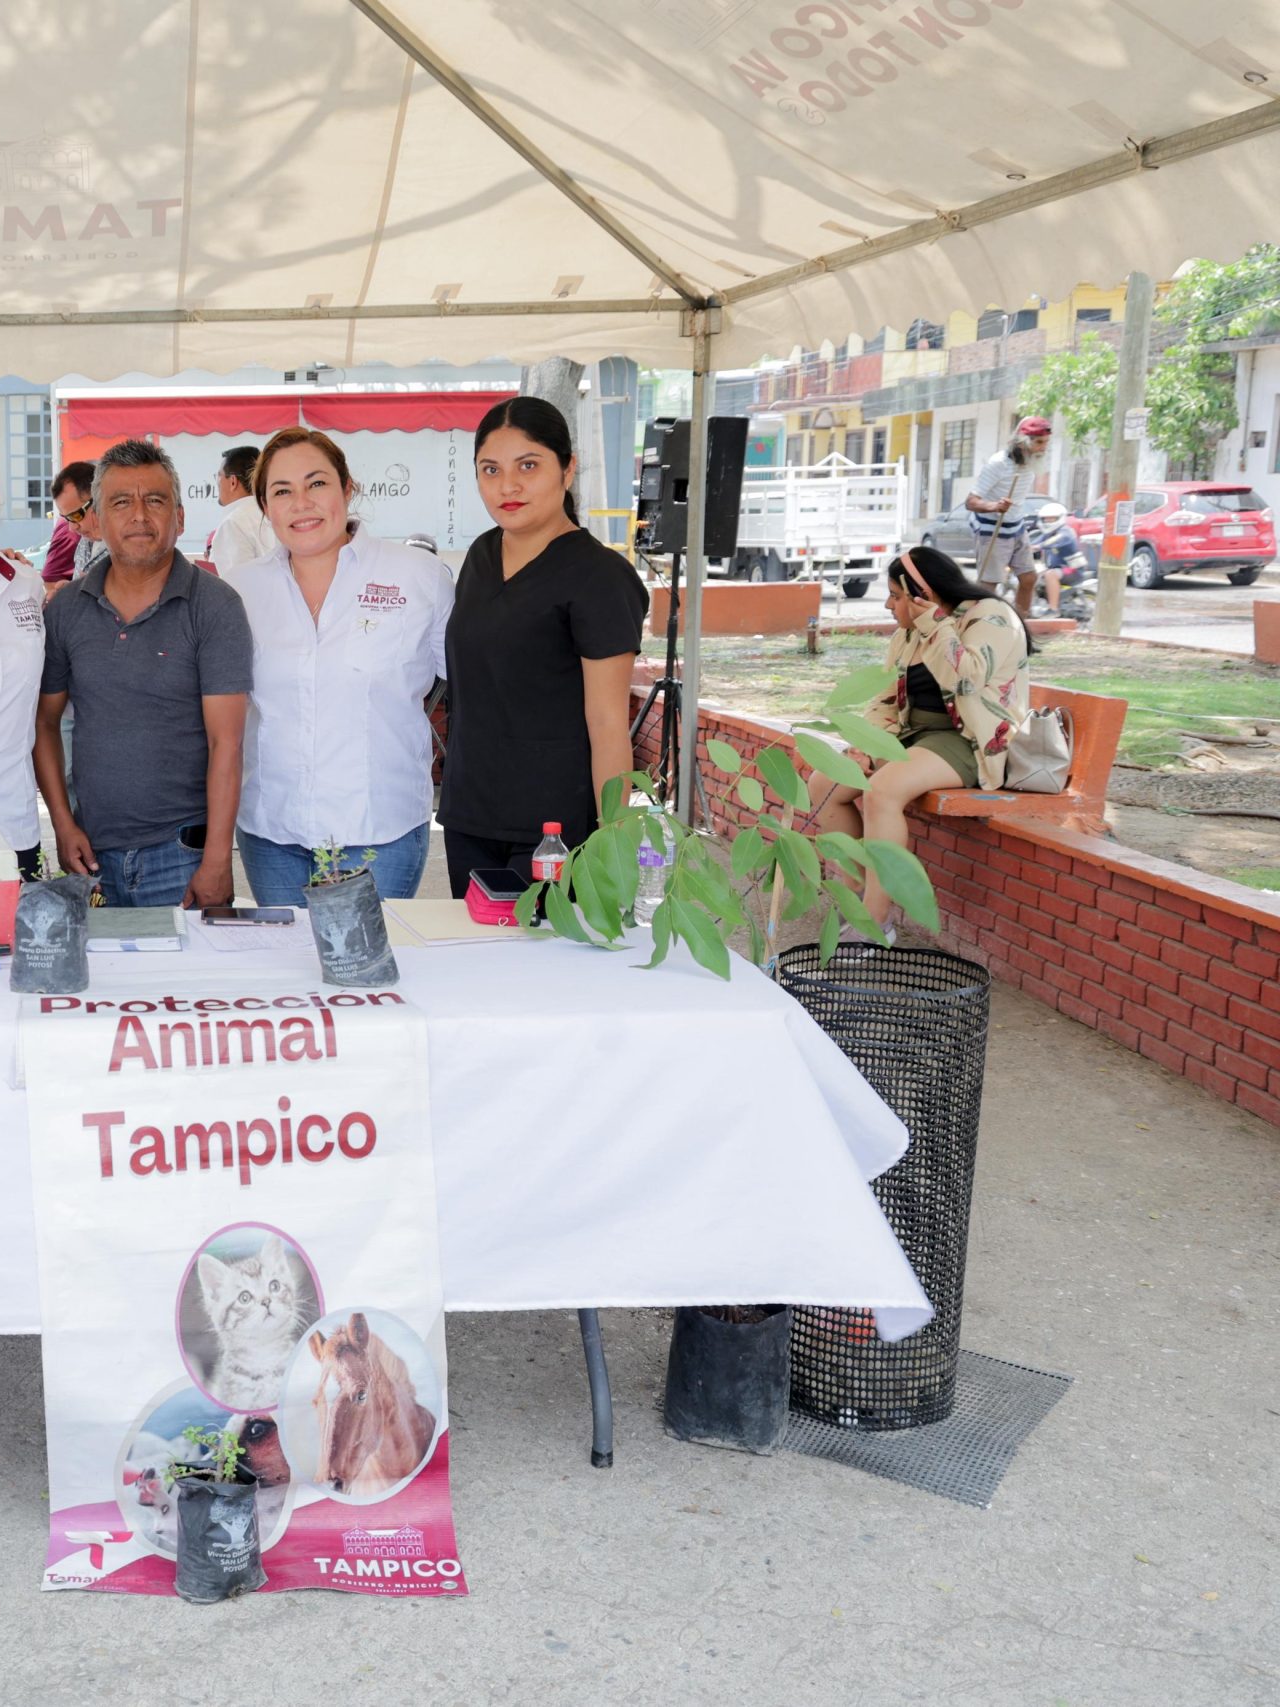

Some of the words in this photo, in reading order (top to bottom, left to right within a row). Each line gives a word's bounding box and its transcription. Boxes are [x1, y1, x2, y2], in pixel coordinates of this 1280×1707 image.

[357, 594, 407, 605] TAMPICO
[40, 990, 407, 1014] Protección
[108, 1008, 337, 1073] Animal
[81, 1095, 377, 1187] Tampico
[220, 1558, 236, 1566] SAN
[237, 1553, 250, 1564] LUIS
[313, 1557, 462, 1577] TAMPICO
[331, 1578, 385, 1588] GOBIERNO
